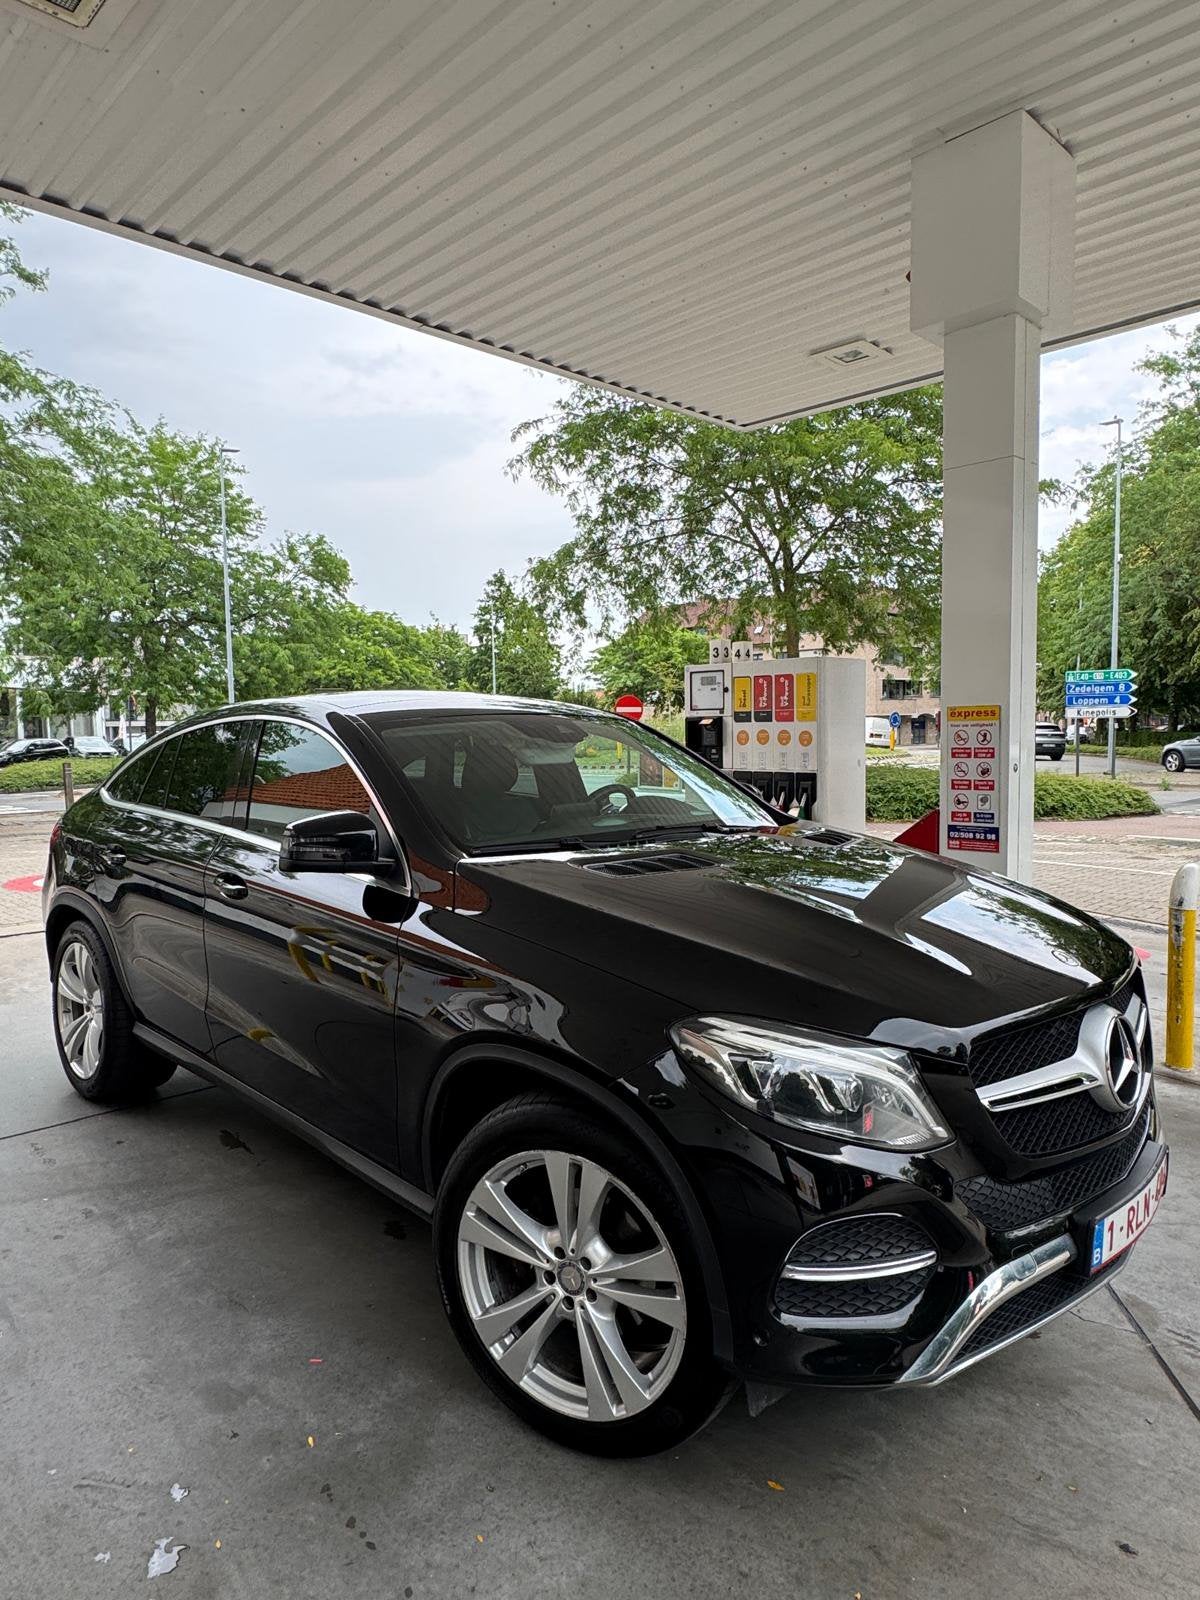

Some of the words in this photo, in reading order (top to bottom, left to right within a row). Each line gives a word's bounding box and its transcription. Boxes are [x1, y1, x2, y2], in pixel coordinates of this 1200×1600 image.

[712, 647, 720, 658] 3
[723, 646, 729, 658] 3
[734, 649, 741, 659] 4
[745, 648, 751, 658] 4
[1076, 673, 1089, 681] E40
[1110, 671, 1128, 679] E403
[1069, 684, 1114, 694] Zedelgem
[1118, 684, 1126, 692] 8
[1072, 696, 1109, 706] Loppem
[1113, 696, 1121, 704] 4
[950, 709, 996, 719] express
[1077, 708, 1117, 717] Kinepolis
[1093, 1248, 1101, 1265] B
